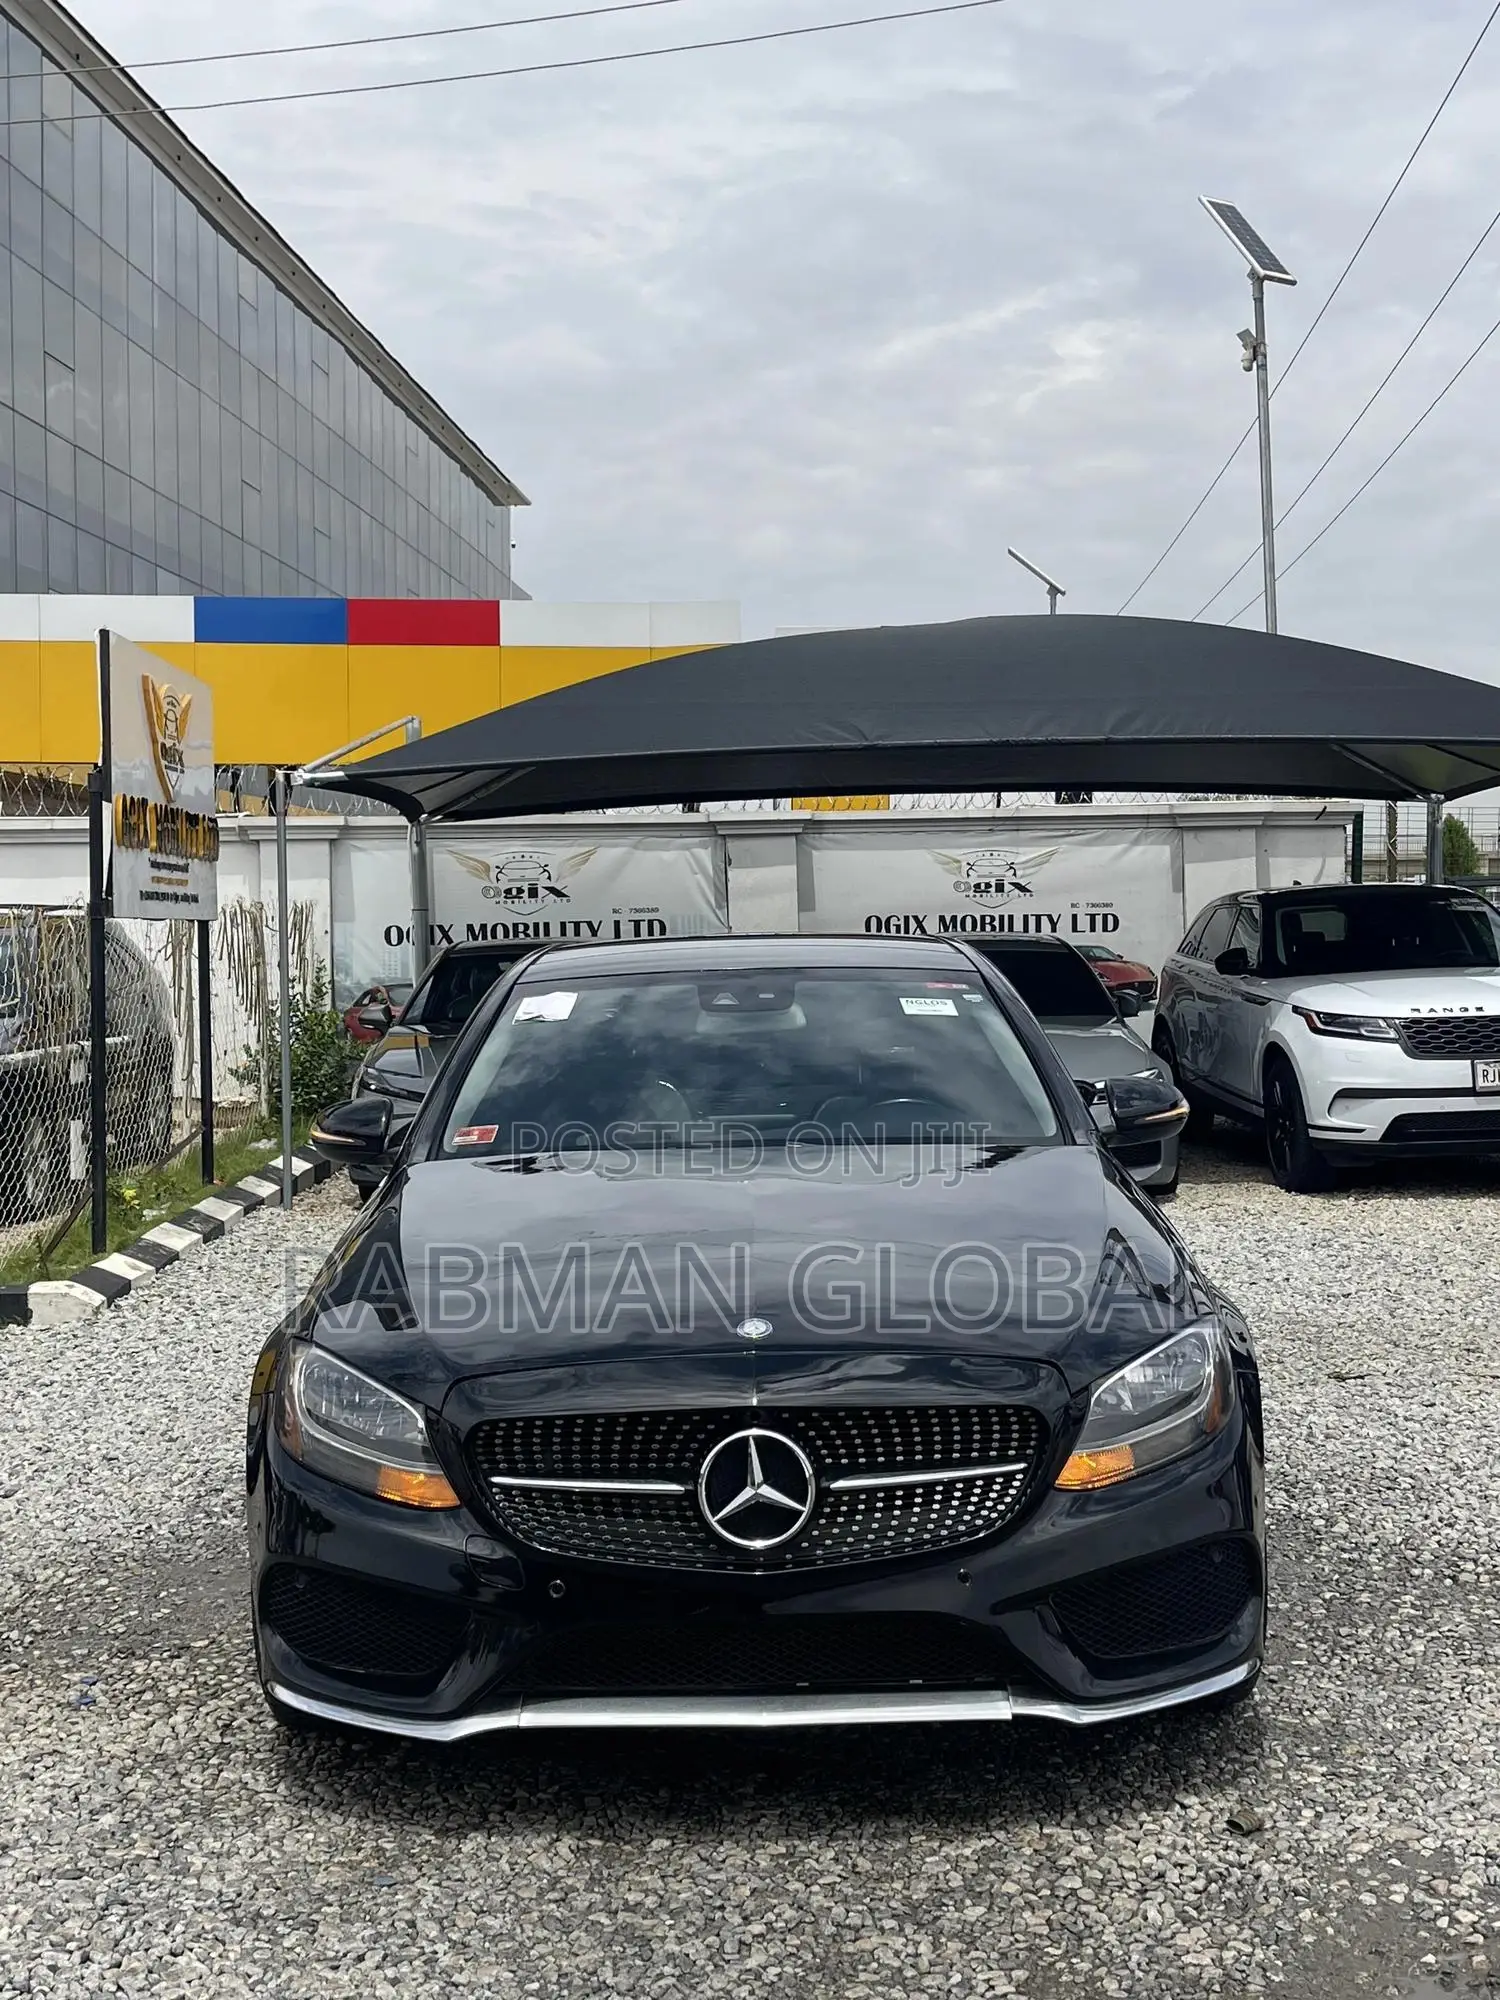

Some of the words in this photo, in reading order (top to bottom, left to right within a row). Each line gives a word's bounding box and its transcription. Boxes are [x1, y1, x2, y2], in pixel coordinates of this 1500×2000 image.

[466, 919, 603, 942] MOBILITY
[864, 914, 928, 936] OGIX
[938, 913, 1062, 934] MOBILITY
[1070, 912, 1120, 934] LTD
[1410, 1006, 1485, 1014] RANGE
[1482, 1068, 1500, 1084] RJ
